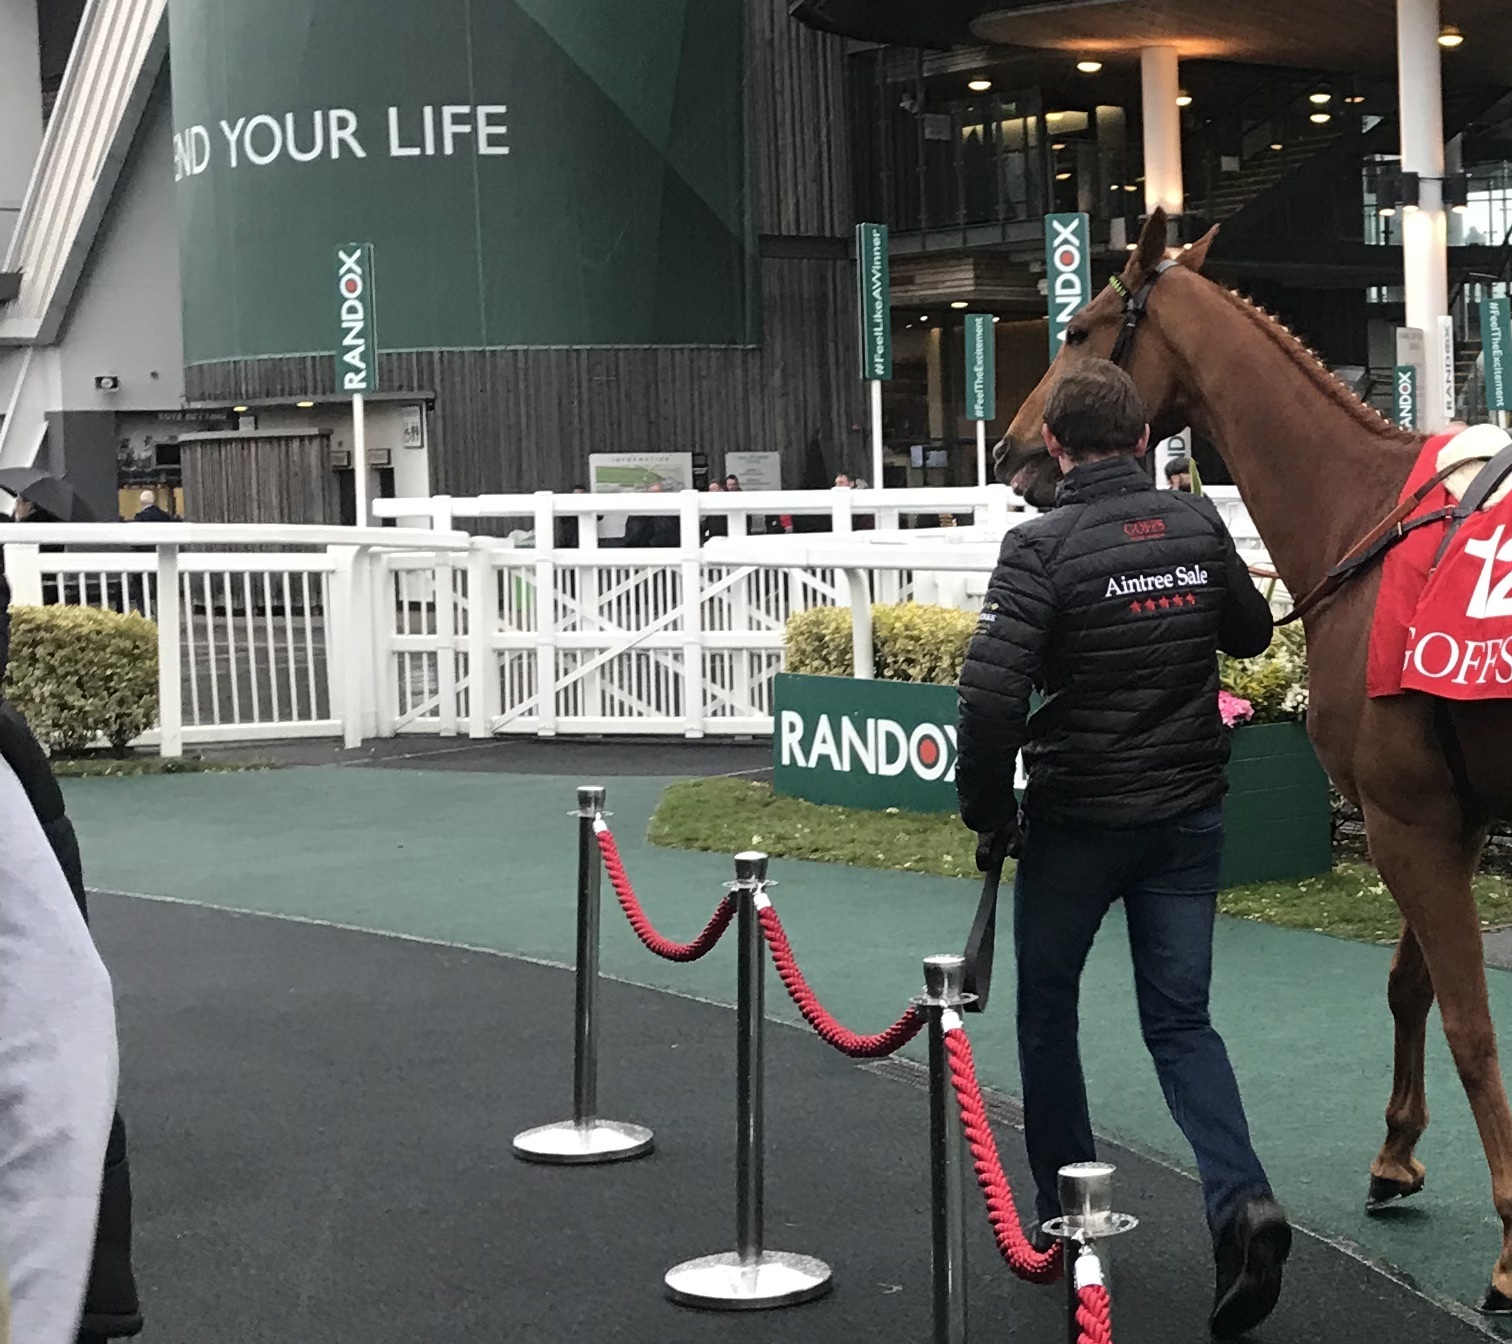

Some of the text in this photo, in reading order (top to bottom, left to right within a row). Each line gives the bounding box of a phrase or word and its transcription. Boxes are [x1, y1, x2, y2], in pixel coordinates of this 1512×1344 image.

[219, 109, 367, 168] YOUR
[388, 105, 510, 157] LIFE
[338, 248, 367, 390] RANDOX
[1105, 564, 1208, 598] Aintree Sale
[781, 711, 959, 782] RANDO
